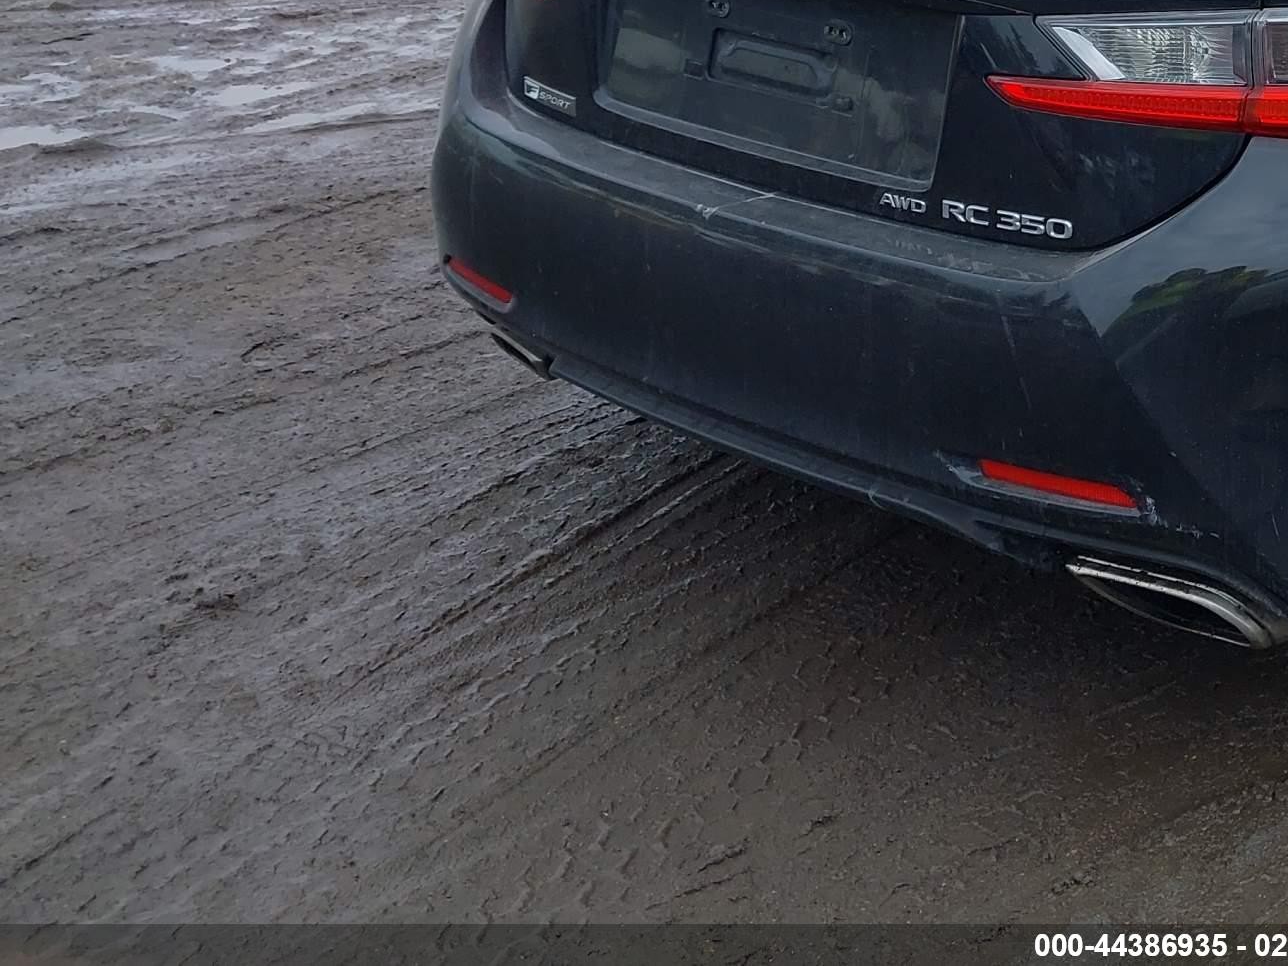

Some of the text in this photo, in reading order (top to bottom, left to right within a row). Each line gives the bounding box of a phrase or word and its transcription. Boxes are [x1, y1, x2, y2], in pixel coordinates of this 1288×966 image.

[539, 91, 571, 109] SPORT
[879, 192, 1074, 239] AWD RC 350
